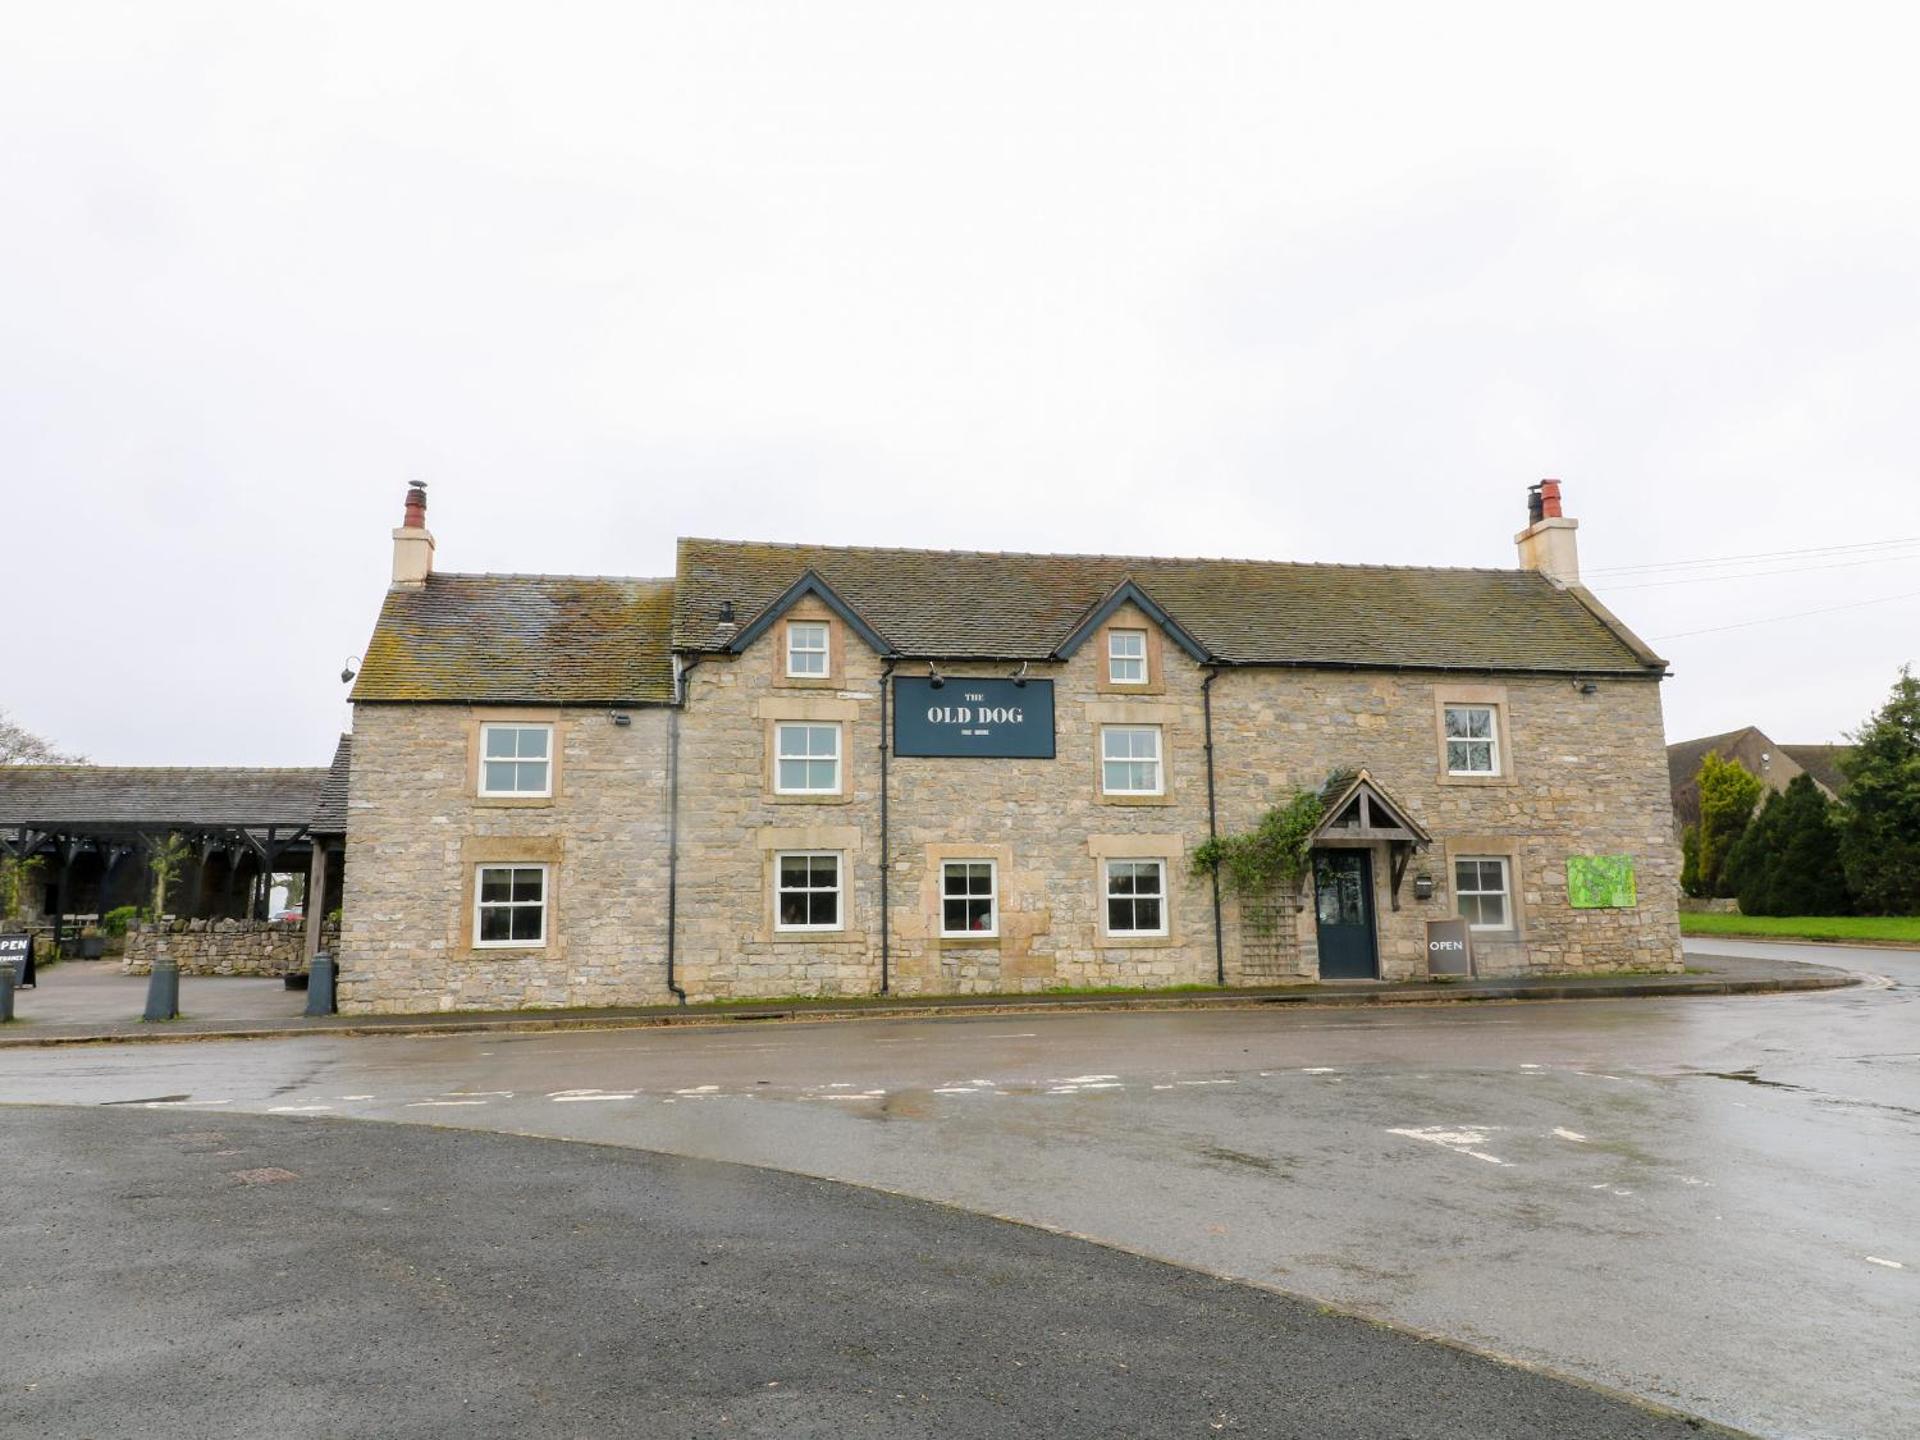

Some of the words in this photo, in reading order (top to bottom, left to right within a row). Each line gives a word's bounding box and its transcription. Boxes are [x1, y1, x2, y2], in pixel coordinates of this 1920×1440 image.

[965, 694, 984, 702] THE
[927, 707, 971, 723] OLD
[978, 707, 1024, 724] DOG
[1429, 941, 1463, 951] OPEN
